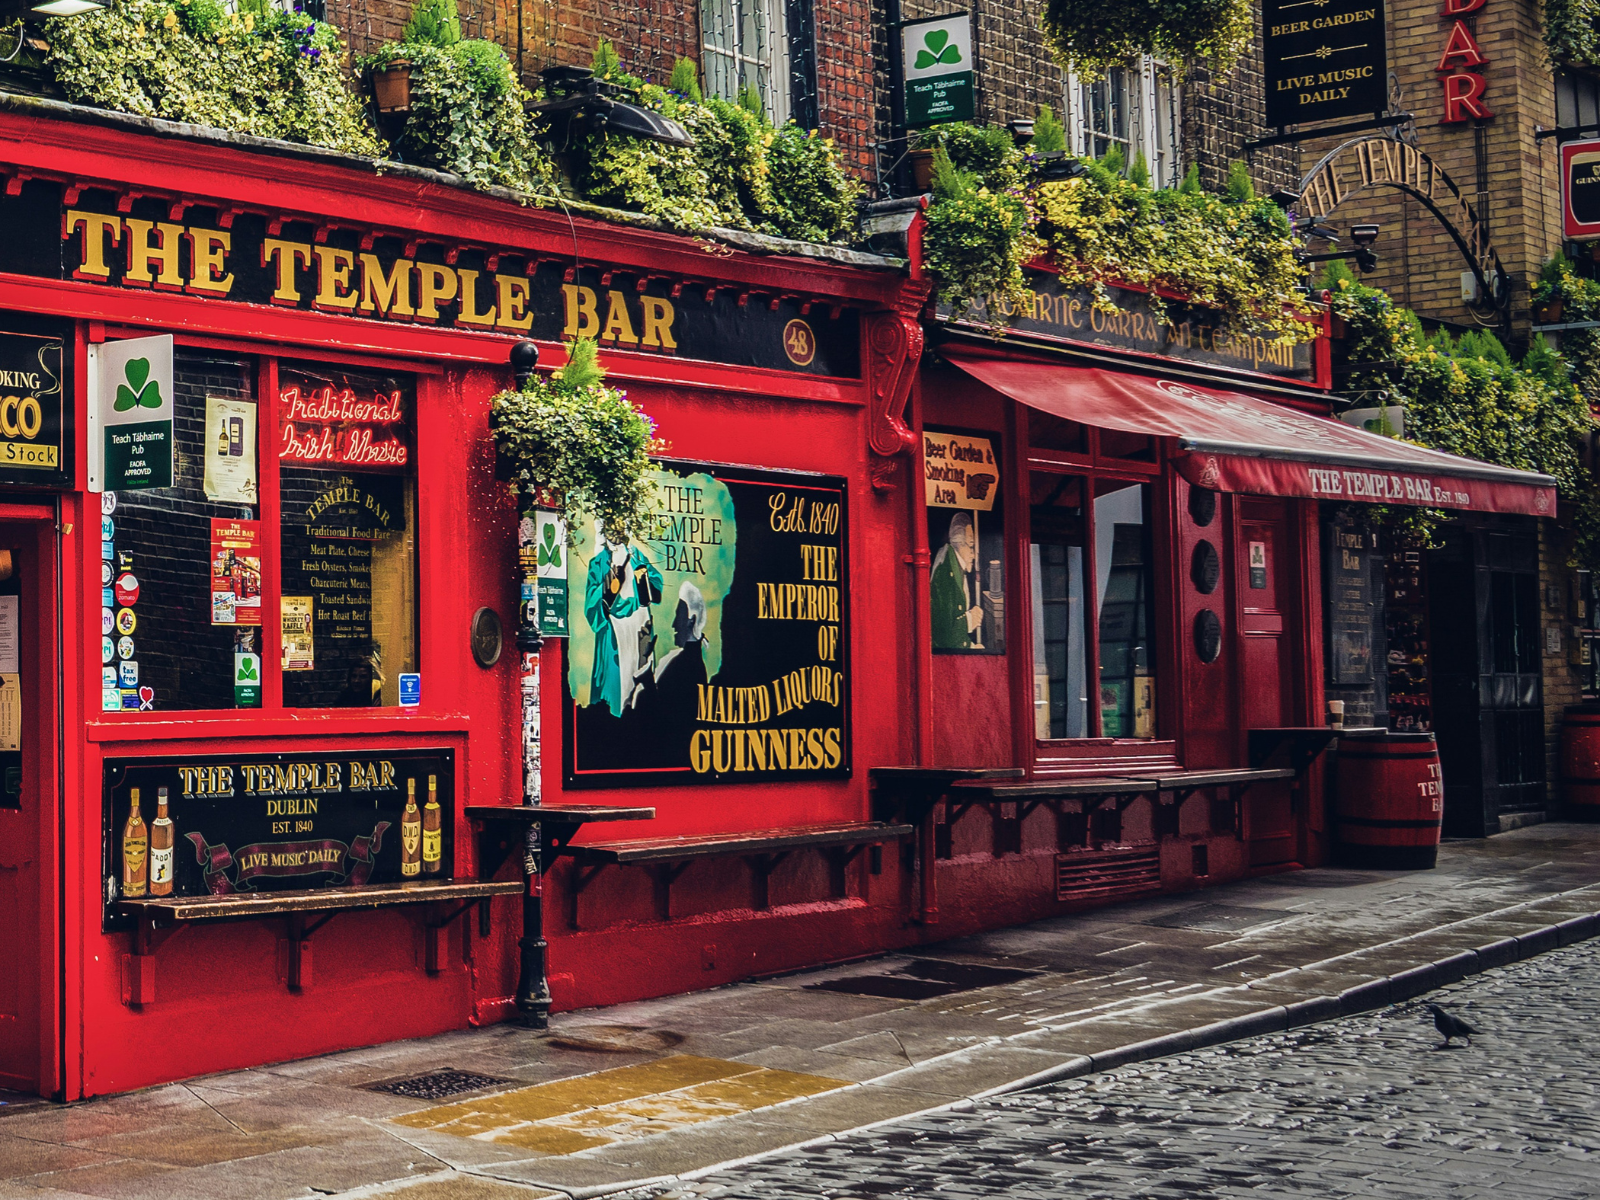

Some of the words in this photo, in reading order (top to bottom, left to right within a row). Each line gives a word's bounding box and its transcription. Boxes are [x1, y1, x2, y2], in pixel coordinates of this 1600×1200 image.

[1271, 21, 1310, 36] BEER
[1312, 9, 1376, 29] GARDEN
[1277, 75, 1315, 91] LIVE
[1318, 66, 1374, 84] MUSIC
[1299, 87, 1351, 105] DAILY
[1302, 155, 1349, 217] THE
[1353, 139, 1443, 206] TEMPLE
[64, 210, 236, 297] THE
[264, 237, 535, 331] TEMPLE
[561, 284, 678, 353] BAR
[787, 326, 808, 356] 48
[279, 388, 401, 420] Traditional
[112, 434, 131, 444] Teach
[131, 445, 145, 455] Pub
[279, 424, 333, 459] Irish
[924, 437, 947, 459] Beer
[949, 440, 984, 463] Garden
[6, 443, 55, 463] Stock
[124, 468, 152, 476] APPROVED
[925, 460, 965, 487] Smoking
[934, 484, 957, 505] Area
[1308, 469, 1343, 494] THE
[1343, 471, 1403, 499] TEMPLE
[1403, 477, 1434, 501] BAR
[305, 487, 361, 521] TEMPLE
[365, 494, 391, 526] BAR
[663, 486, 704, 515] THE
[647, 512, 722, 546] TEMPLE
[808, 501, 839, 536] 1840
[216, 529, 241, 537] TEMPLE
[242, 530, 255, 538] BAR
[305, 524, 349, 537] Traditional
[352, 526, 371, 538] Food
[374, 528, 391, 539] Fare
[1335, 526, 1363, 549] TEMPLE
[310, 544, 327, 555] Meat
[348, 546, 370, 557] Cheese
[665, 543, 706, 575] BAR
[800, 544, 837, 582] THE
[1342, 549, 1360, 570] BAR
[302, 560, 320, 571] Fresh
[320, 593, 345, 605] Toasted
[756, 582, 840, 622] EMPEROR
[318, 609, 331, 620] Hot
[332, 610, 350, 620] Roast
[352, 610, 367, 621] Beef
[817, 625, 839, 662] OF
[122, 666, 135, 674] tax
[122, 674, 137, 684] free
[696, 683, 770, 725] MALTED
[771, 664, 843, 716] LIQUORS
[689, 727, 842, 774] GUINNESS
[178, 765, 235, 798] THE
[241, 762, 341, 796] TEMPLE
[348, 760, 398, 792] BAR
[266, 798, 319, 816] DUBLIN
[272, 821, 292, 835] EST.
[294, 820, 314, 833] 1840
[151, 851, 172, 862] PADDY
[241, 854, 269, 871] LIVE
[271, 852, 306, 867] MUSIC
[307, 850, 342, 865] DAILY
